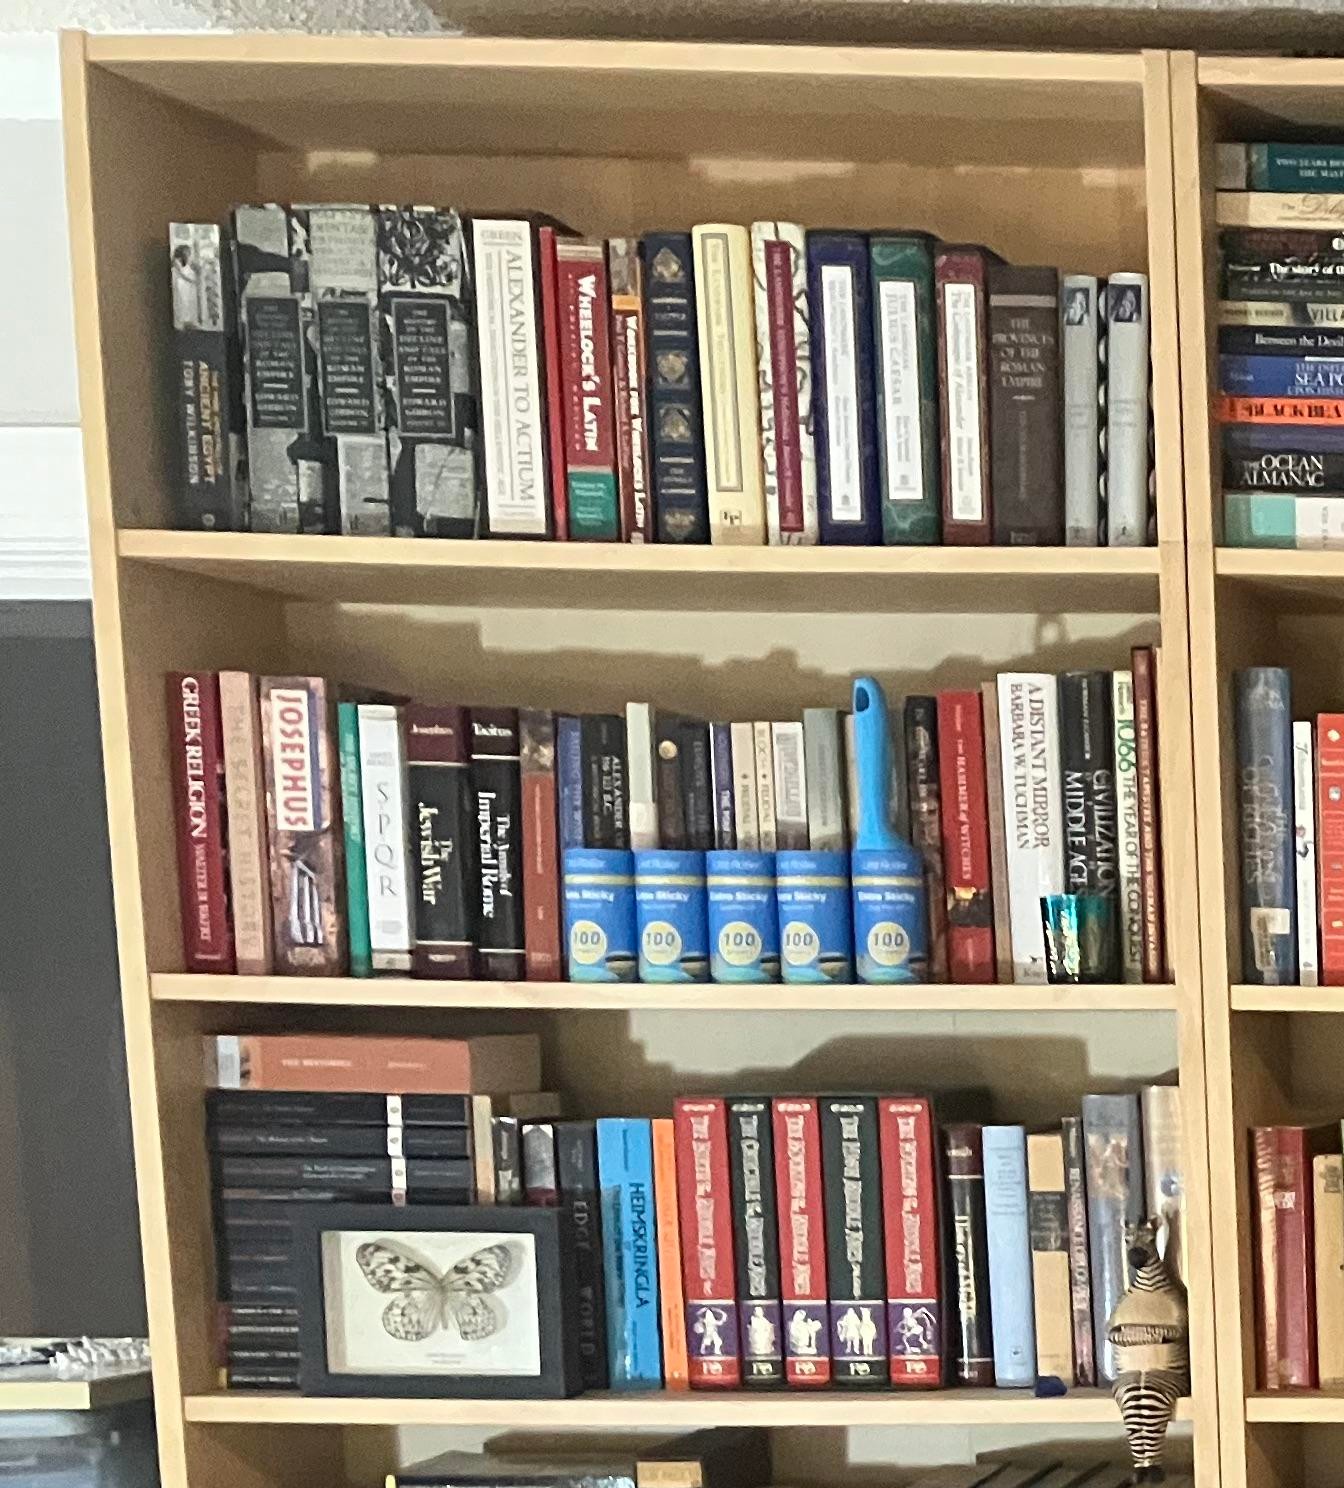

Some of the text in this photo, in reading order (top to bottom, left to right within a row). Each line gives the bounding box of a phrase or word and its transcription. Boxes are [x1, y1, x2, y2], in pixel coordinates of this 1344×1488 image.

[505, 250, 536, 502] ALEXANDER TO ACTIUM
[1240, 471, 1324, 488] ALMANAC
[1261, 455, 1323, 471] OCEAN
[276, 694, 310, 827] JOSEPHUS
[1028, 697, 1046, 769] DISTANT
[1030, 774, 1050, 849] MIRROR
[724, 932, 756, 948] 100
[629, 1181, 650, 1310] HEIMSKRINGLA
